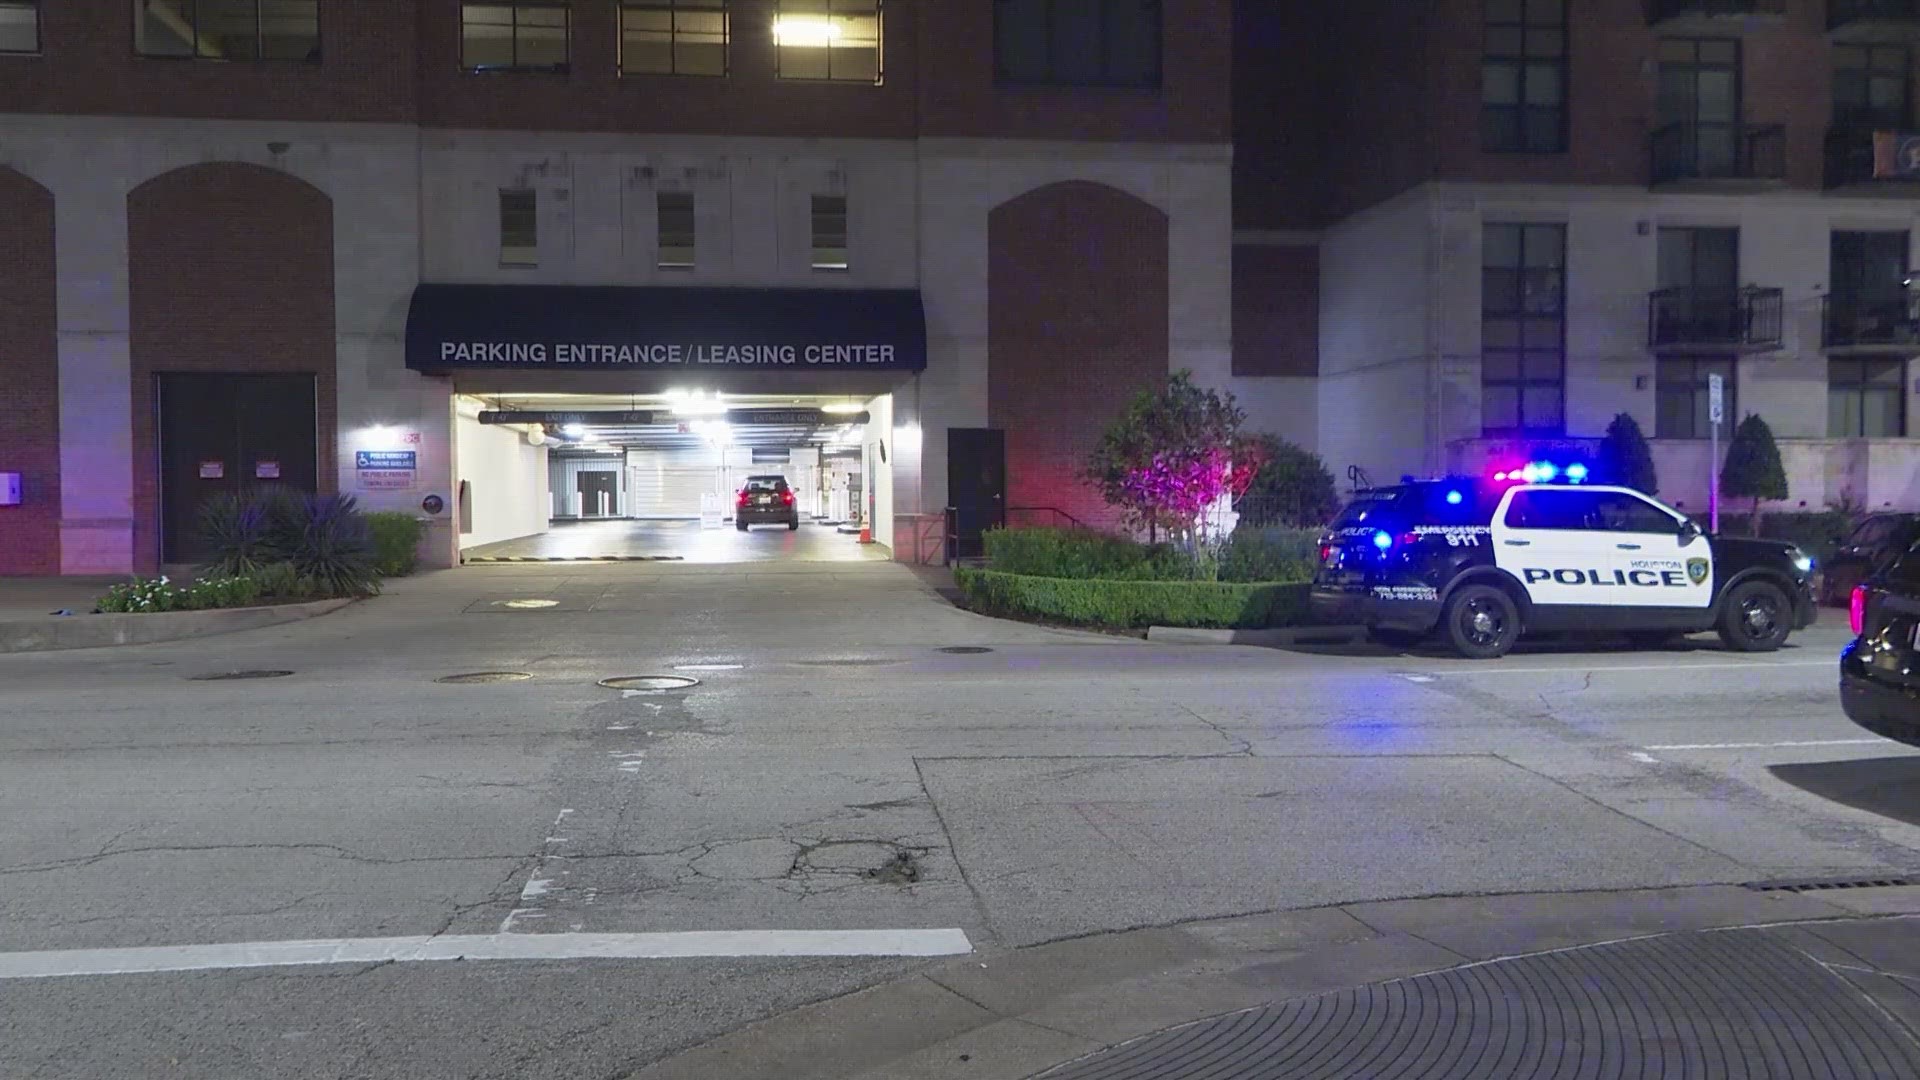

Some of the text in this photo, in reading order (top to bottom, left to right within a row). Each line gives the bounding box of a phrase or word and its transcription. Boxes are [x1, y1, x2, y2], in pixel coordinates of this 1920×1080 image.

[440, 342, 547, 362] PARKING
[804, 345, 895, 363] CENTER
[545, 413, 562, 421] EXIT
[753, 414, 817, 422] ENTRANCE ONLY
[1414, 525, 1490, 534] EMERGENCY
[1445, 534, 1479, 547] 911
[1630, 560, 1682, 569] HOUSTON
[1522, 568, 1688, 587] POLICE
